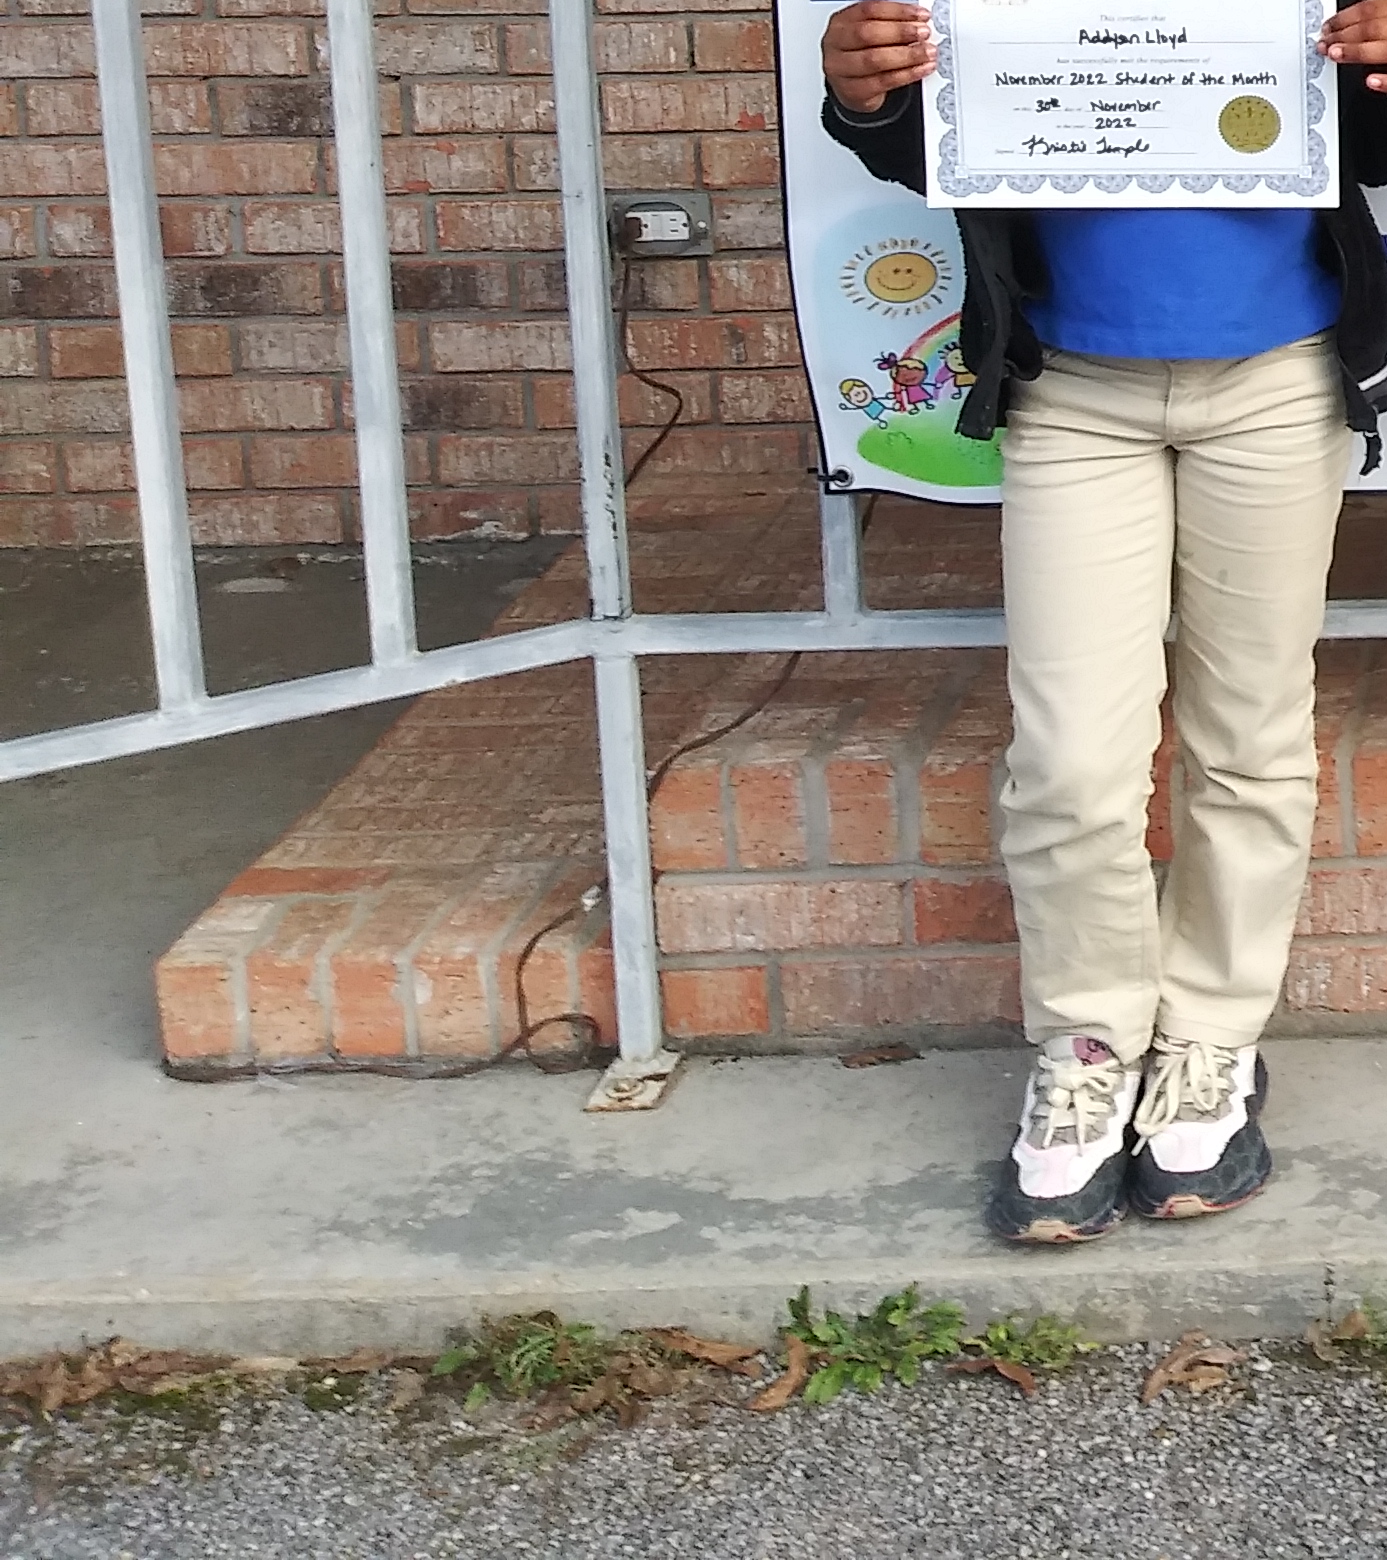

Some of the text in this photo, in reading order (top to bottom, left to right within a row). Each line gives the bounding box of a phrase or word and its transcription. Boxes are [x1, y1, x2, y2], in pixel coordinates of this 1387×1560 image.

[1145, 27, 1188, 49] Lloyd
[995, 71, 1278, 86] November 2022 Student of the Month
[1090, 99, 1161, 112] November
[1094, 117, 1137, 129] 2022
